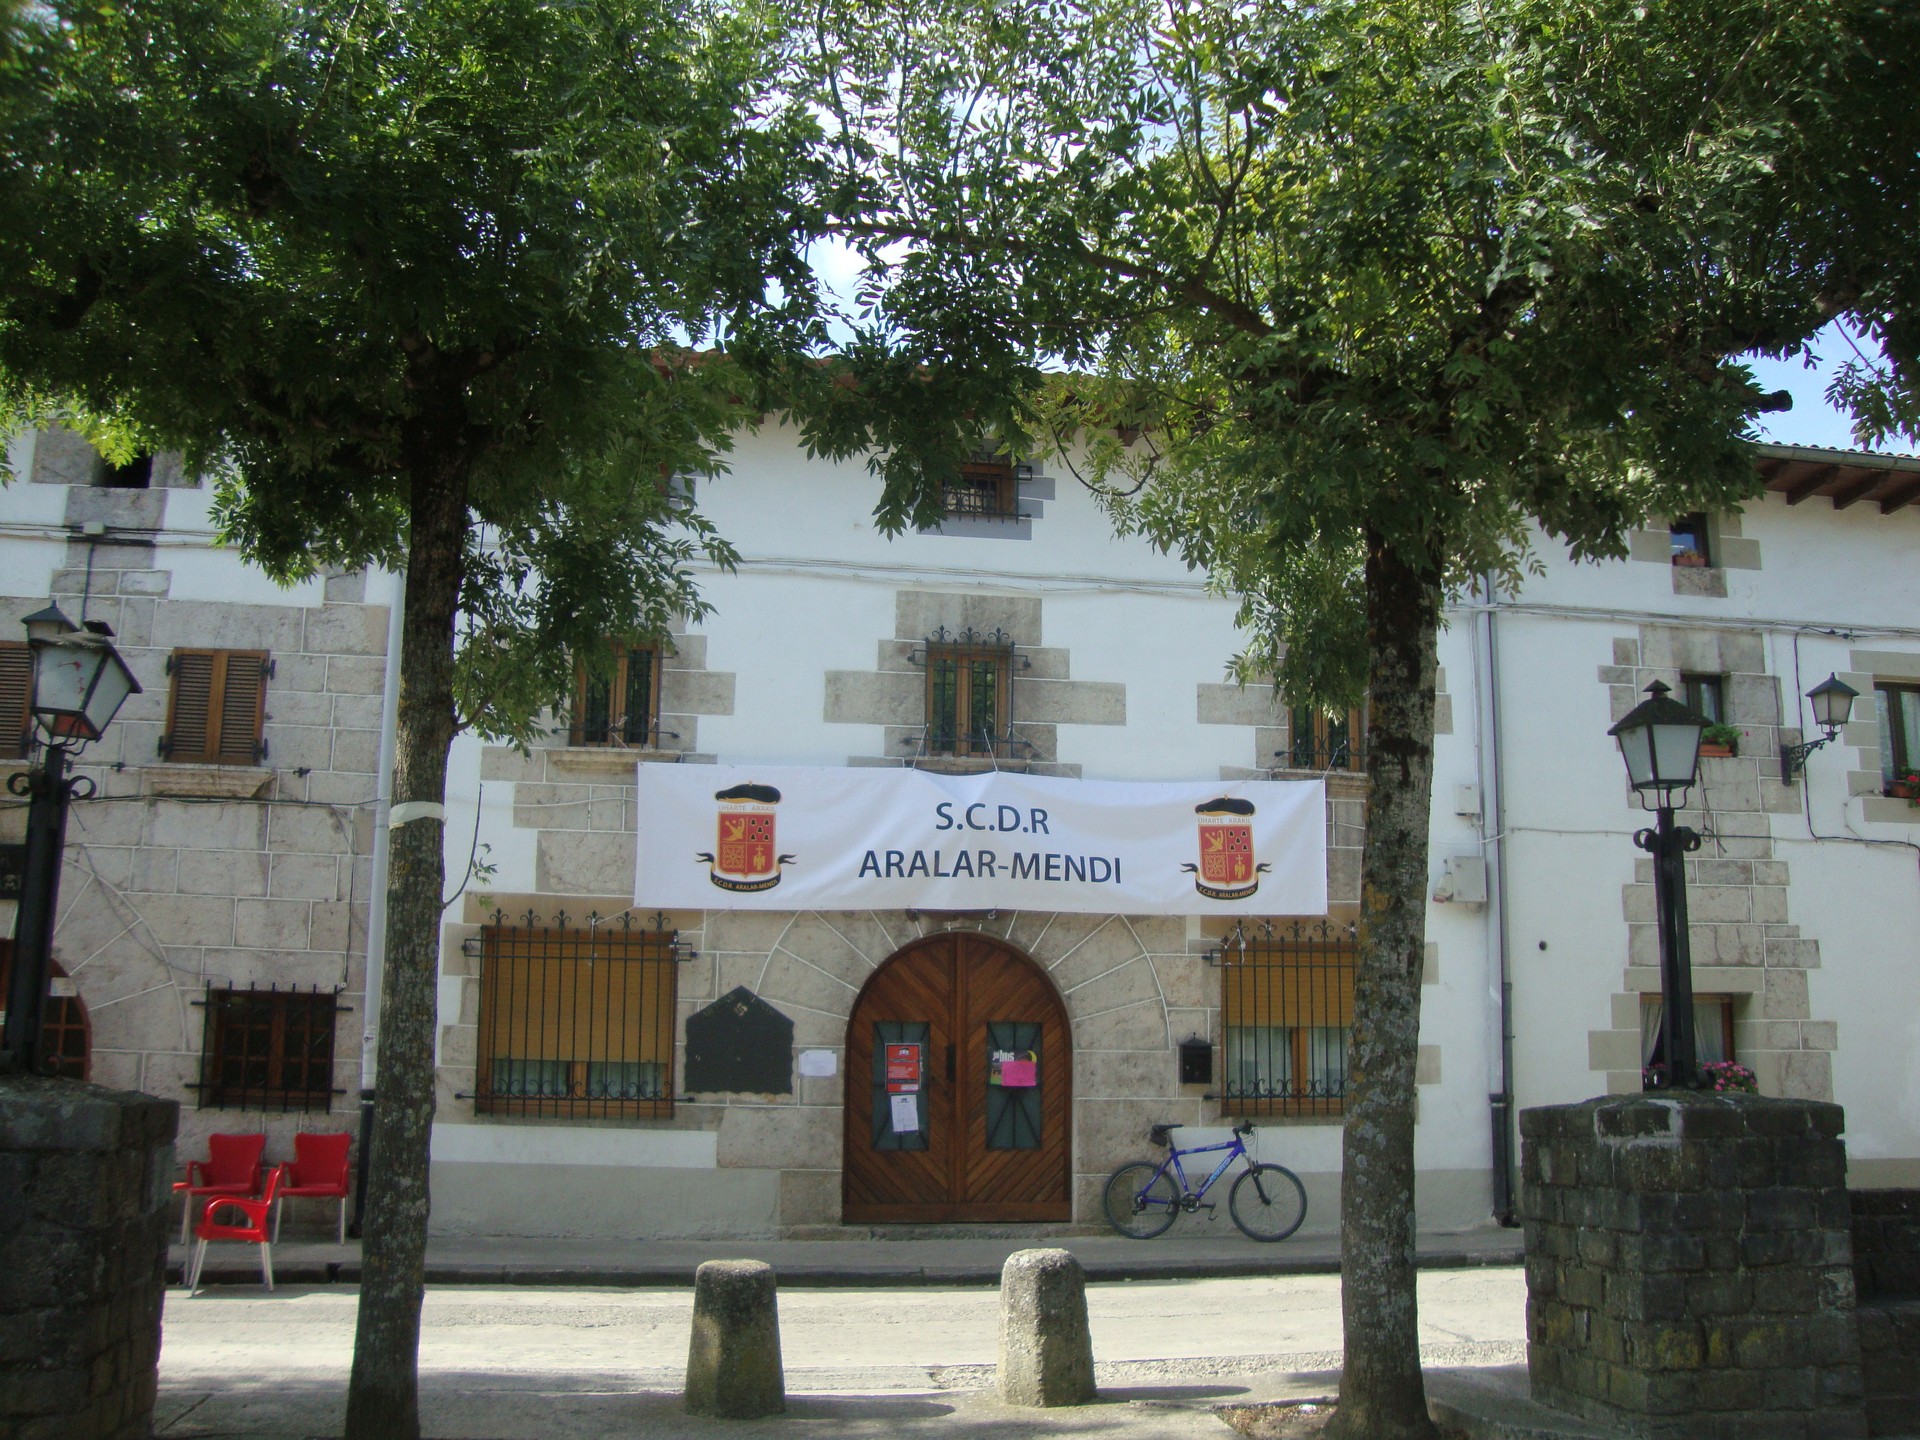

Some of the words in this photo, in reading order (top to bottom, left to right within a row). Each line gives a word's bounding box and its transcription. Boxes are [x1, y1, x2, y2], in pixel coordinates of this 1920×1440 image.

[935, 802, 1050, 835] S.C.D.R
[858, 850, 1121, 884] ARALAR-MENDI
[735, 879, 779, 890] ARALAR-MENDI
